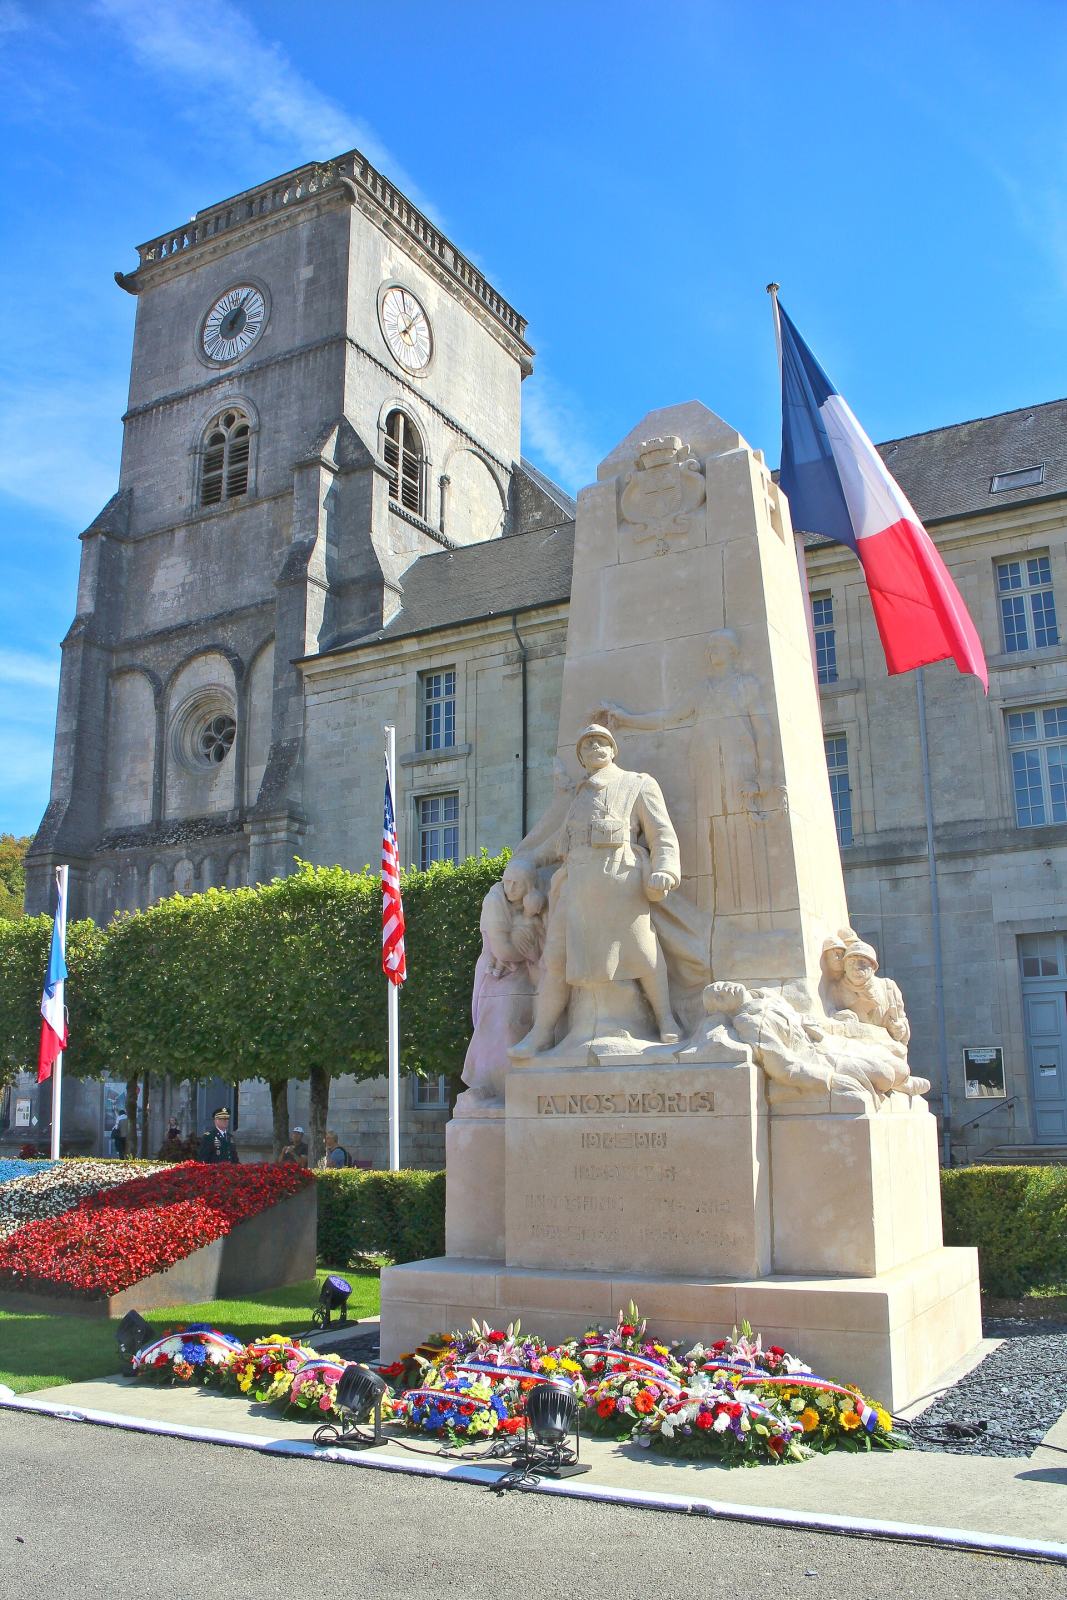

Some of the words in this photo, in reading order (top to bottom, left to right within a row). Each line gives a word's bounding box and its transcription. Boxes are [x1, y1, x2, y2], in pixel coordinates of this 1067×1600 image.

[539, 1095, 560, 1115] A
[567, 1094, 617, 1114] NOS
[626, 1092, 713, 1113] MORTS
